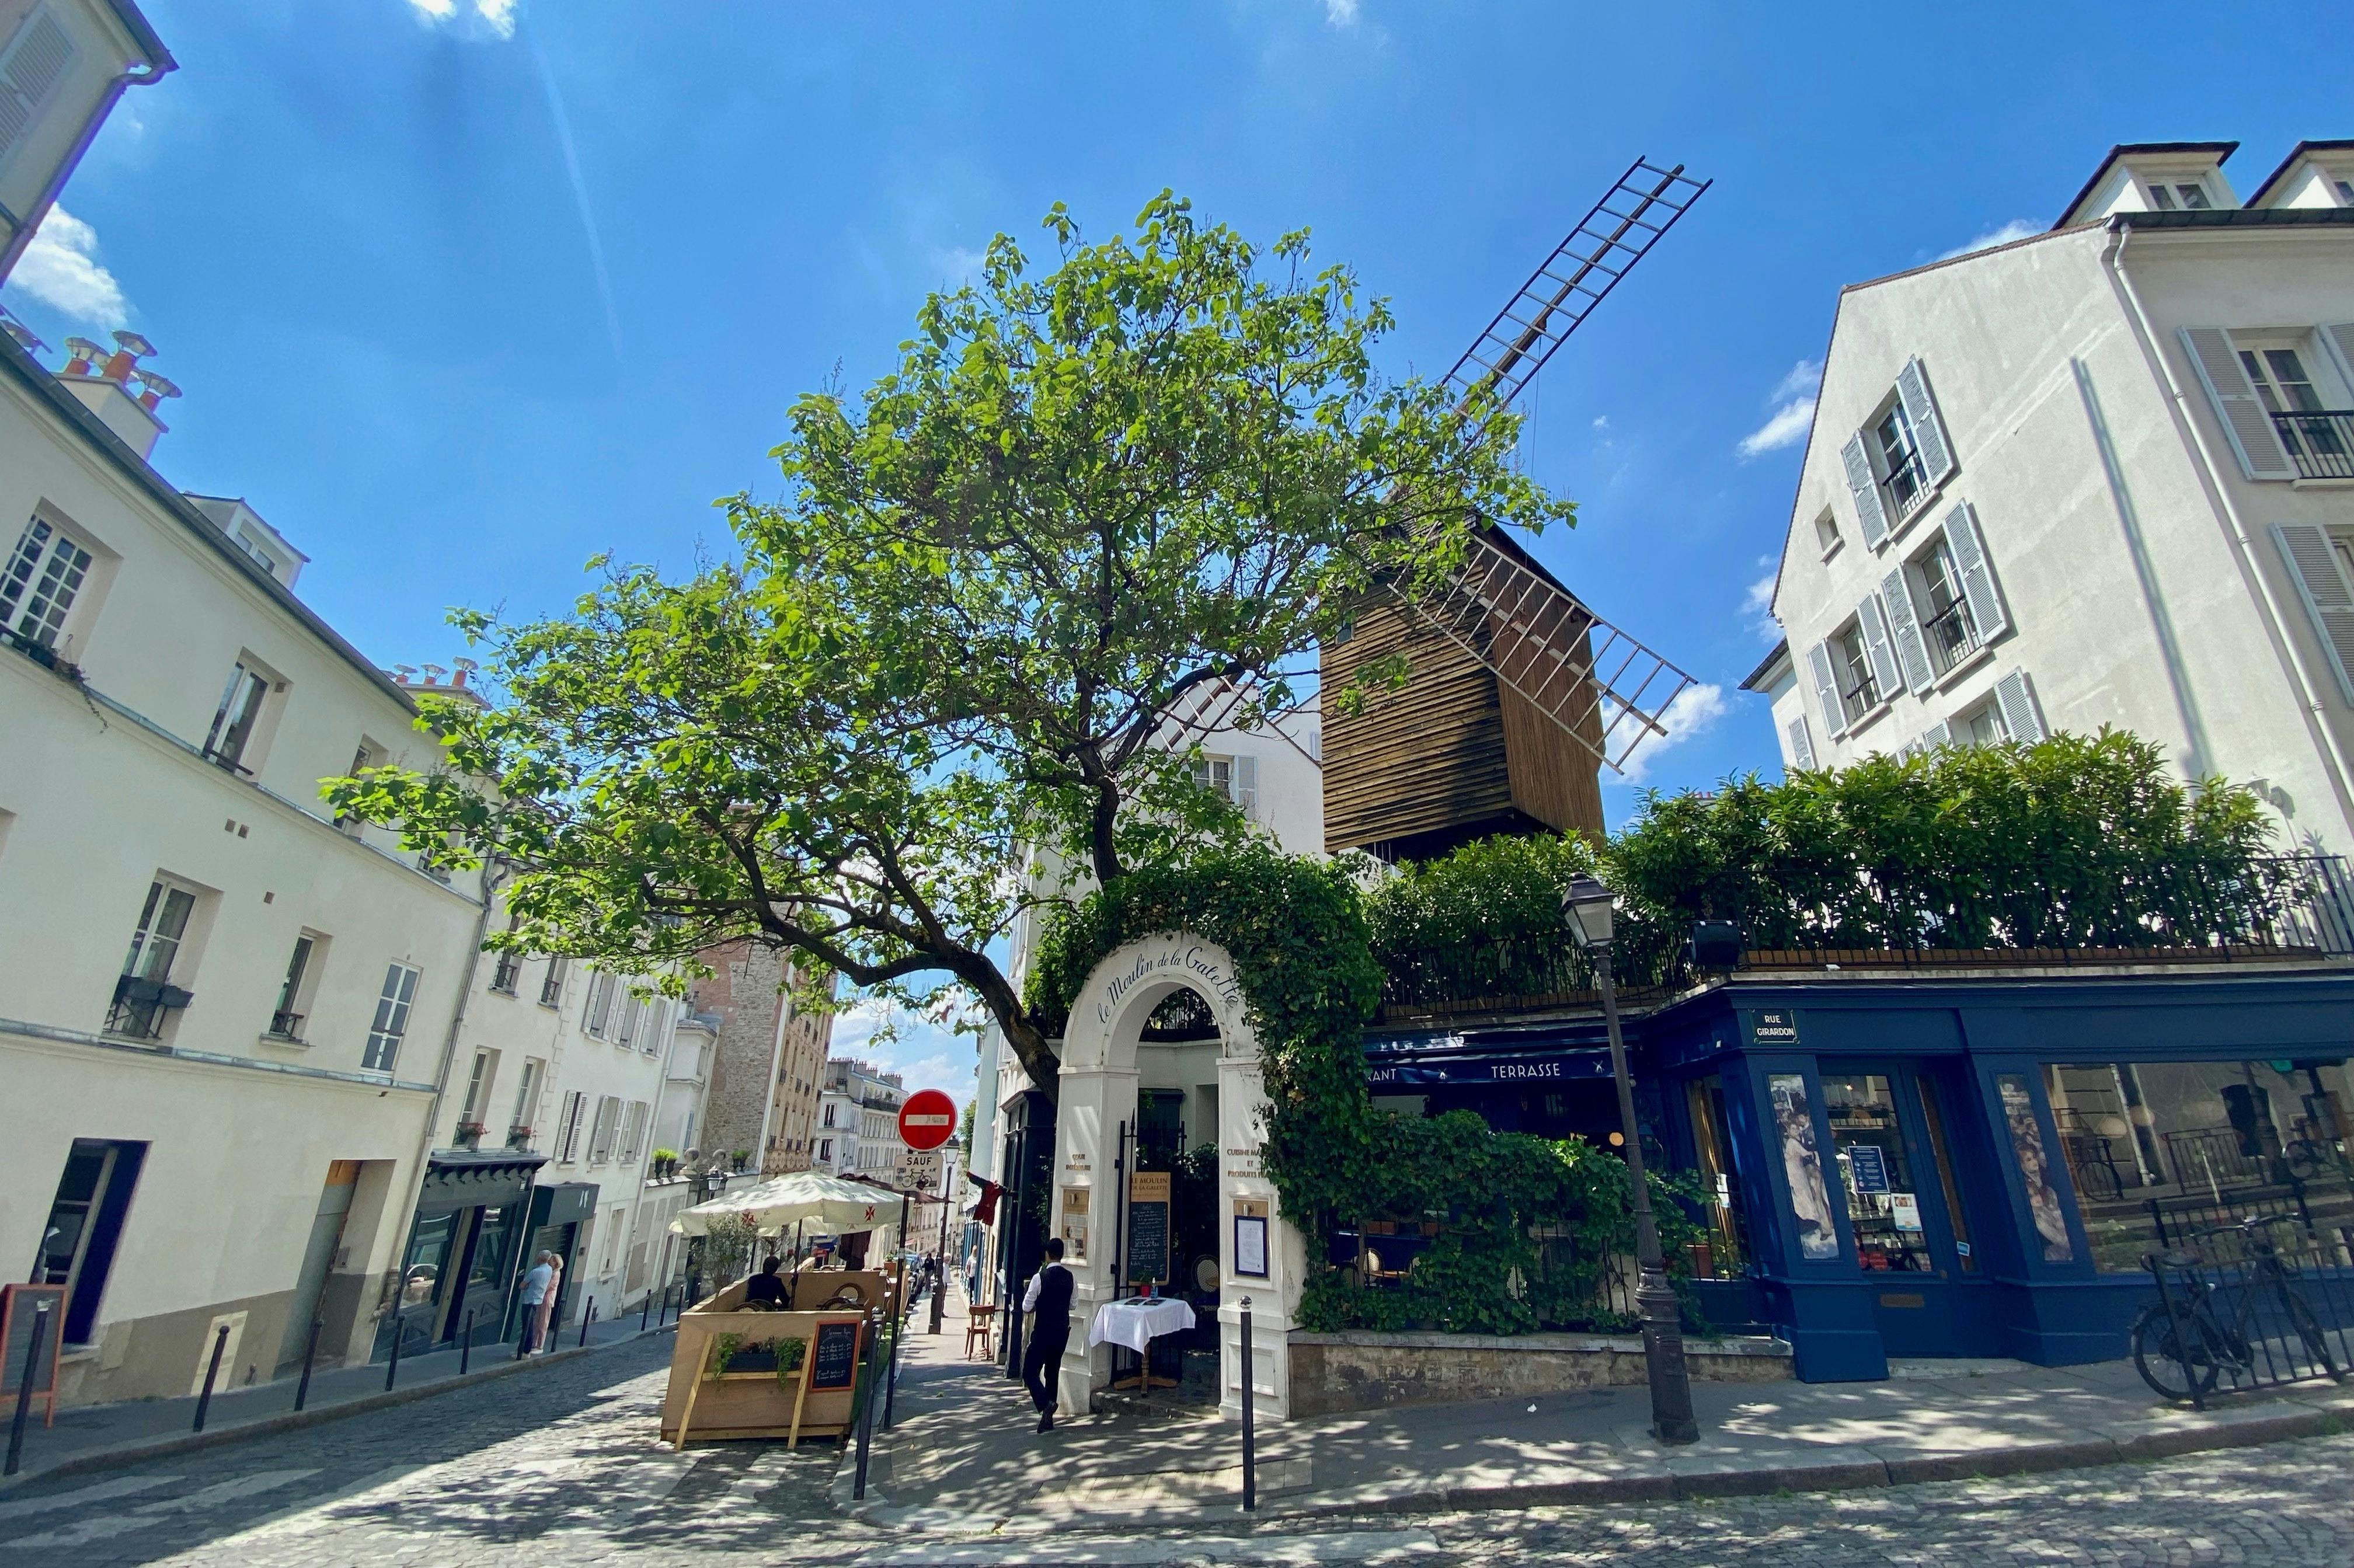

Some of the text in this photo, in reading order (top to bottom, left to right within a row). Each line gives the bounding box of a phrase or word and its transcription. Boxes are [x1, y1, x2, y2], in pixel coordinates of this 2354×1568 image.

[1097, 946, 1239, 1025] le Moulin de la Galette
[1764, 1015, 1781, 1023] RUE
[1756, 1027, 1795, 1036] GIRARDON
[1491, 1062, 1561, 1078] TERRASSE
[906, 1156, 932, 1165] SAUF
